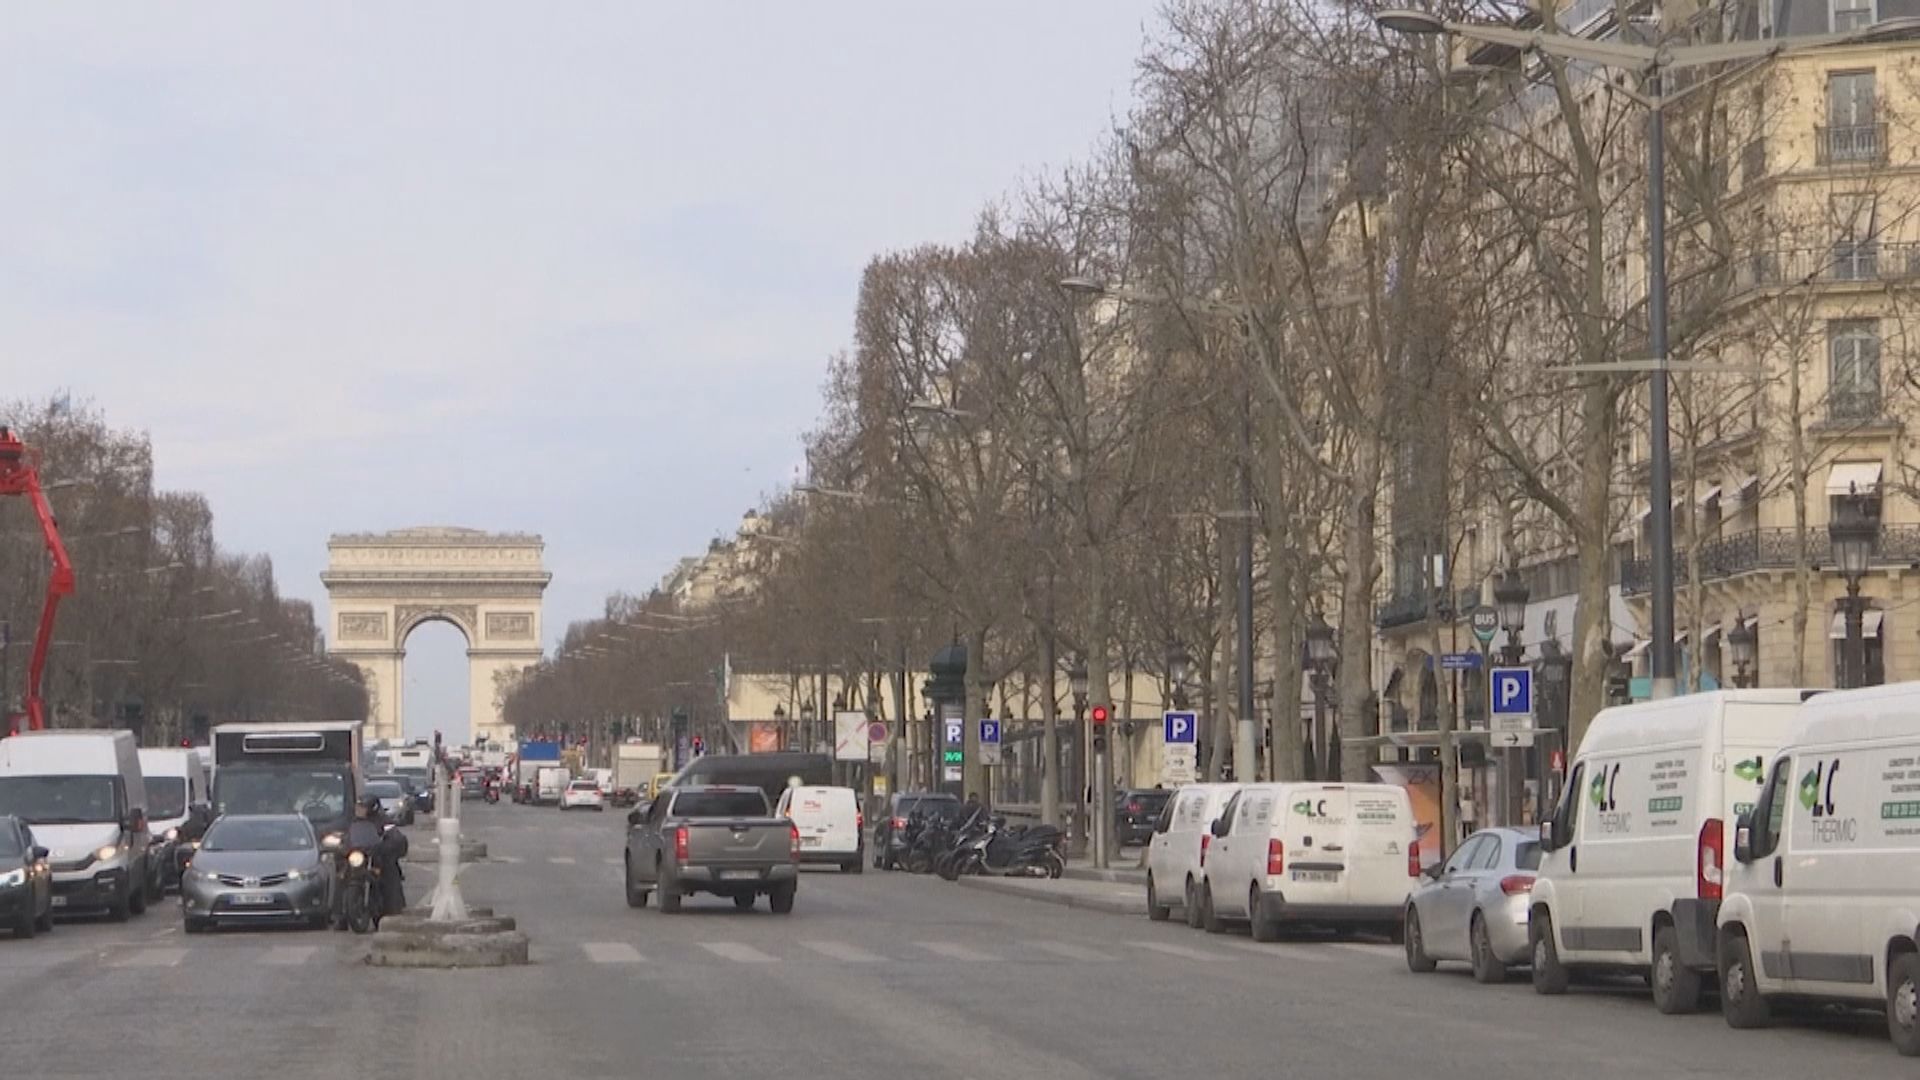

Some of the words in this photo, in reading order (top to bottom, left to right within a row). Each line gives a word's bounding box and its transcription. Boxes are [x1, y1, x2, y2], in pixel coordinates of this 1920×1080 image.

[1474, 614, 1496, 625] BUS
[1501, 677, 1521, 707] P
[983, 724, 994, 740] P
[1172, 718, 1188, 739] P
[1600, 762, 1620, 811] LC
[1812, 760, 1840, 817] LC
[1306, 799, 1327, 817] LC
[1599, 812, 1632, 833] THERMIC
[1811, 817, 1857, 843] THERMIC
